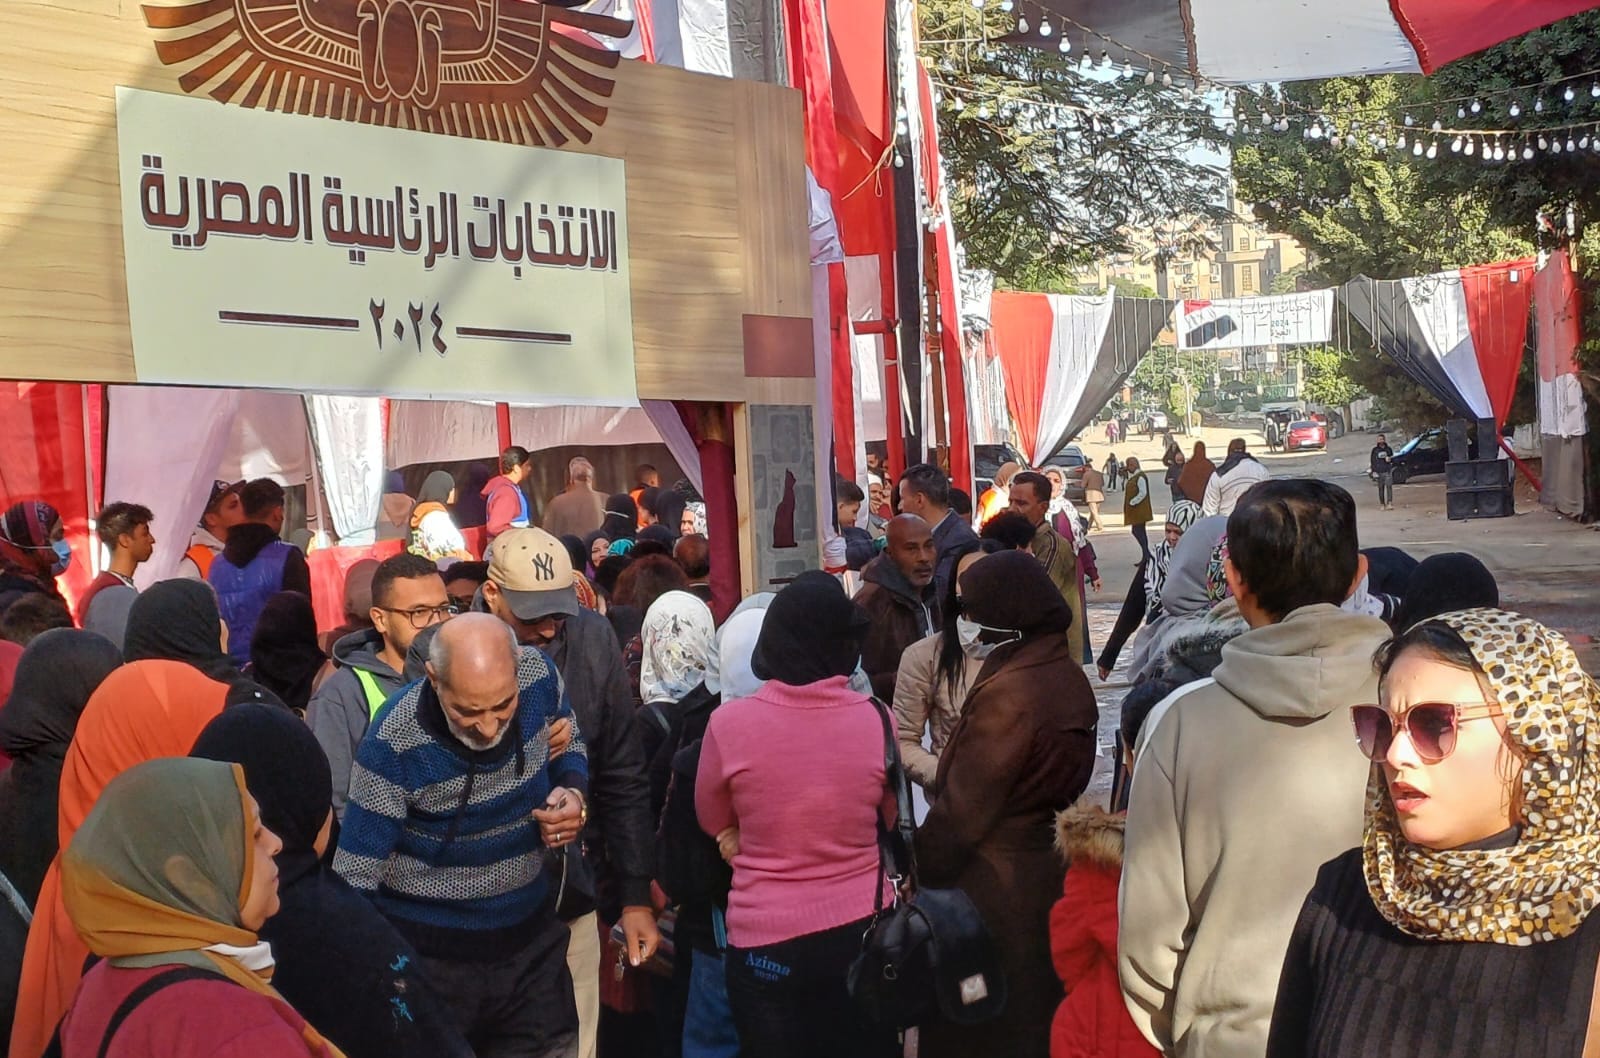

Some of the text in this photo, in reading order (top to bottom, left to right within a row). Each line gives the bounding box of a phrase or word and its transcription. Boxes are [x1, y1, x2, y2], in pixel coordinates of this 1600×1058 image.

[140, 154, 617, 279] الانتخابات الرئاسية المصرية
[369, 297, 448, 356] ٢٠٢٤
[532, 552, 554, 581] NY
